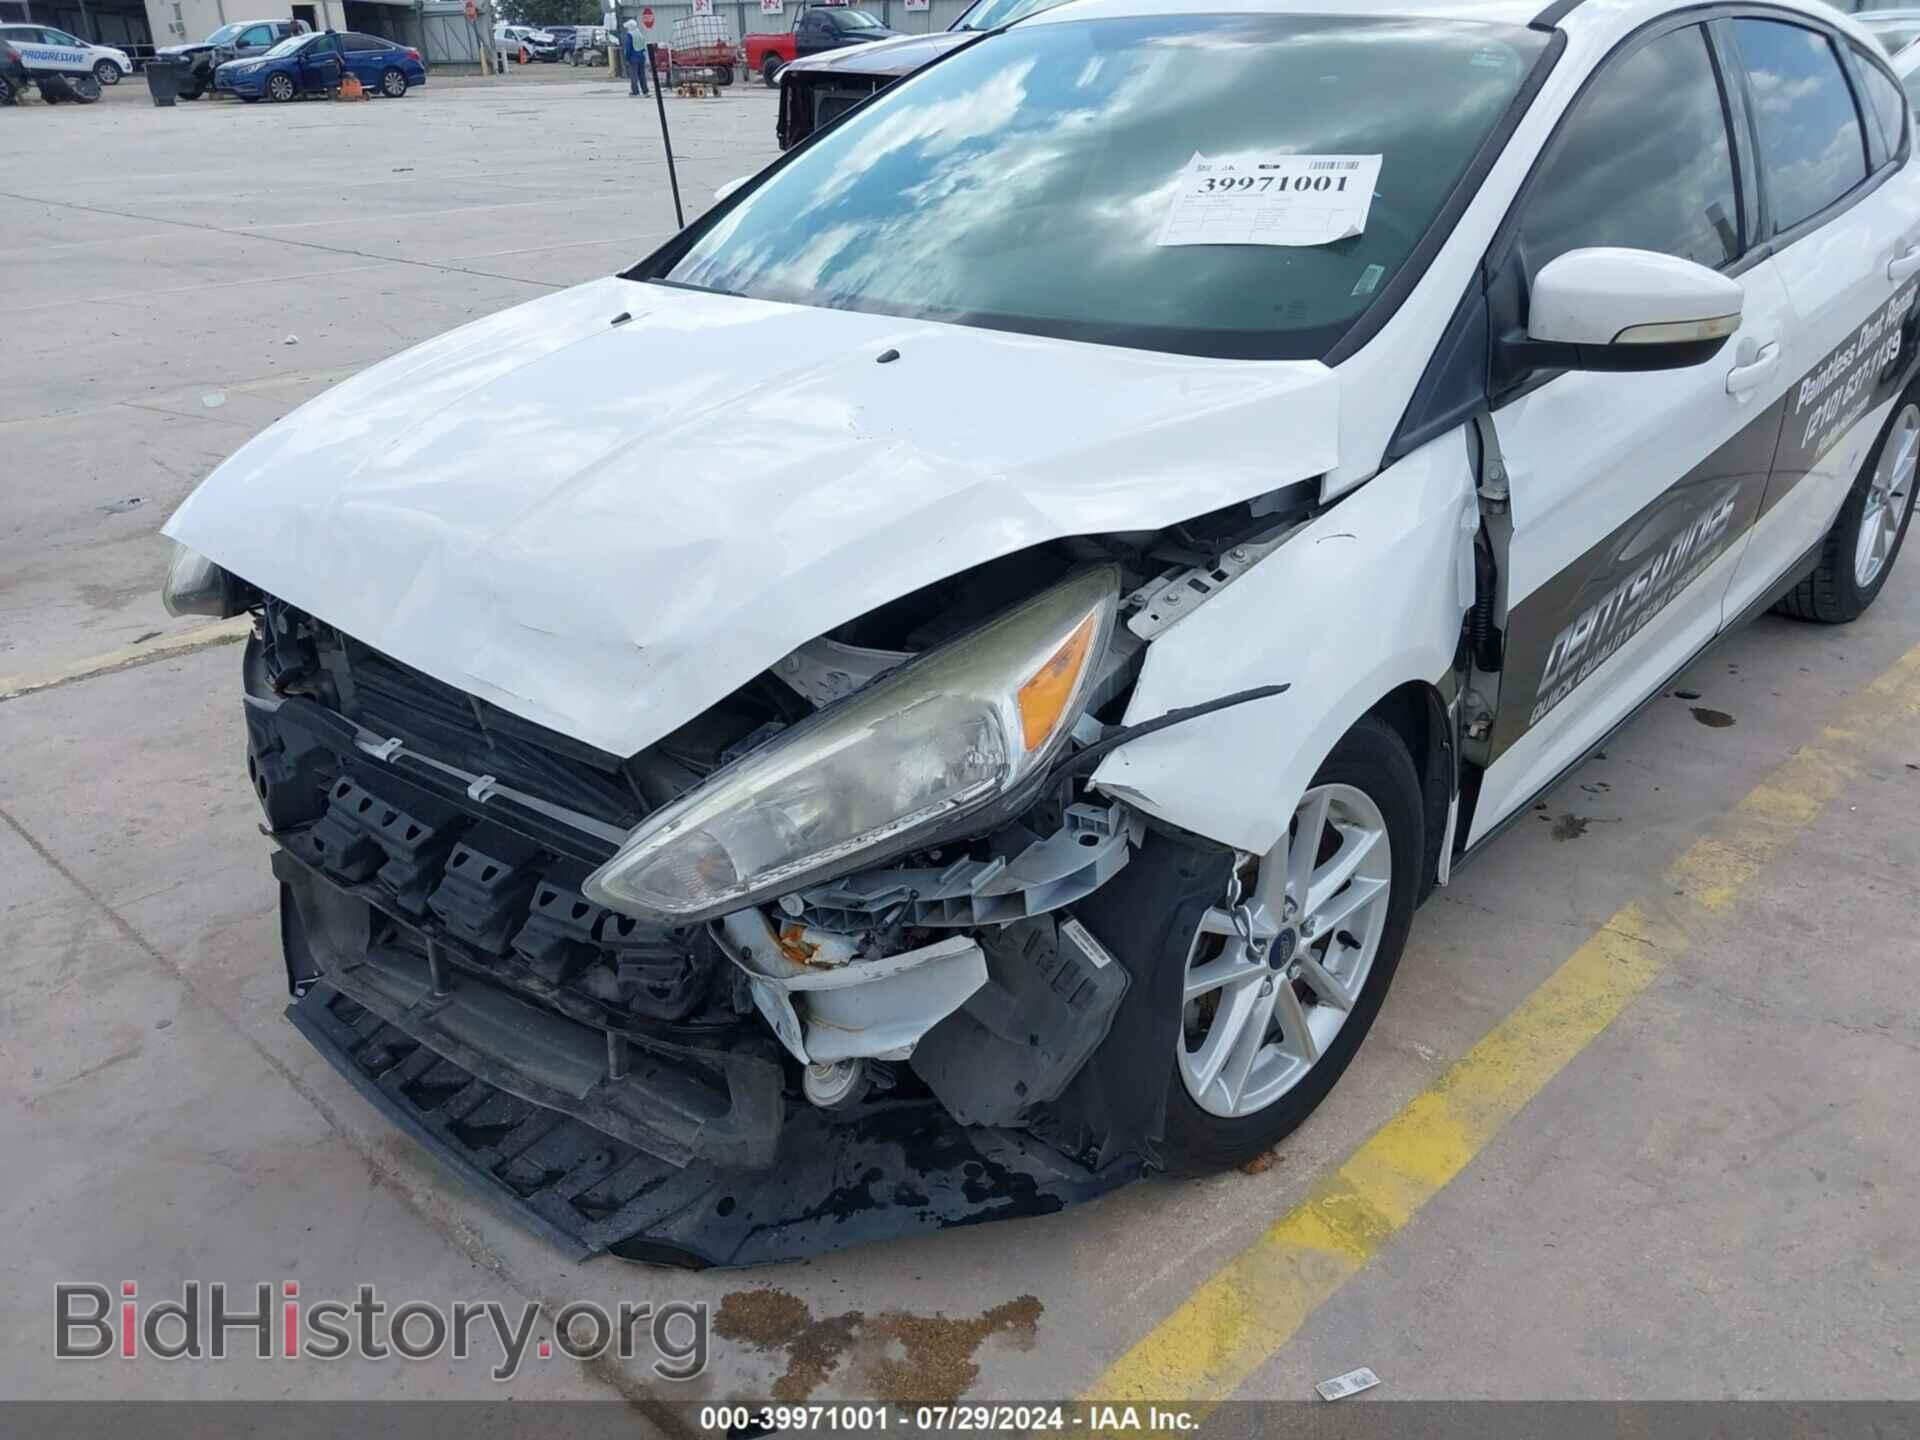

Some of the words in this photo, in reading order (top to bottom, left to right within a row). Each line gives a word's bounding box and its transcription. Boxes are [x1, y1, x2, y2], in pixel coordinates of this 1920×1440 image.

[21, 49, 84, 63] PROGRESSIVE
[1198, 175, 1347, 193] 39971001
[1529, 671, 1577, 726] QUICK
